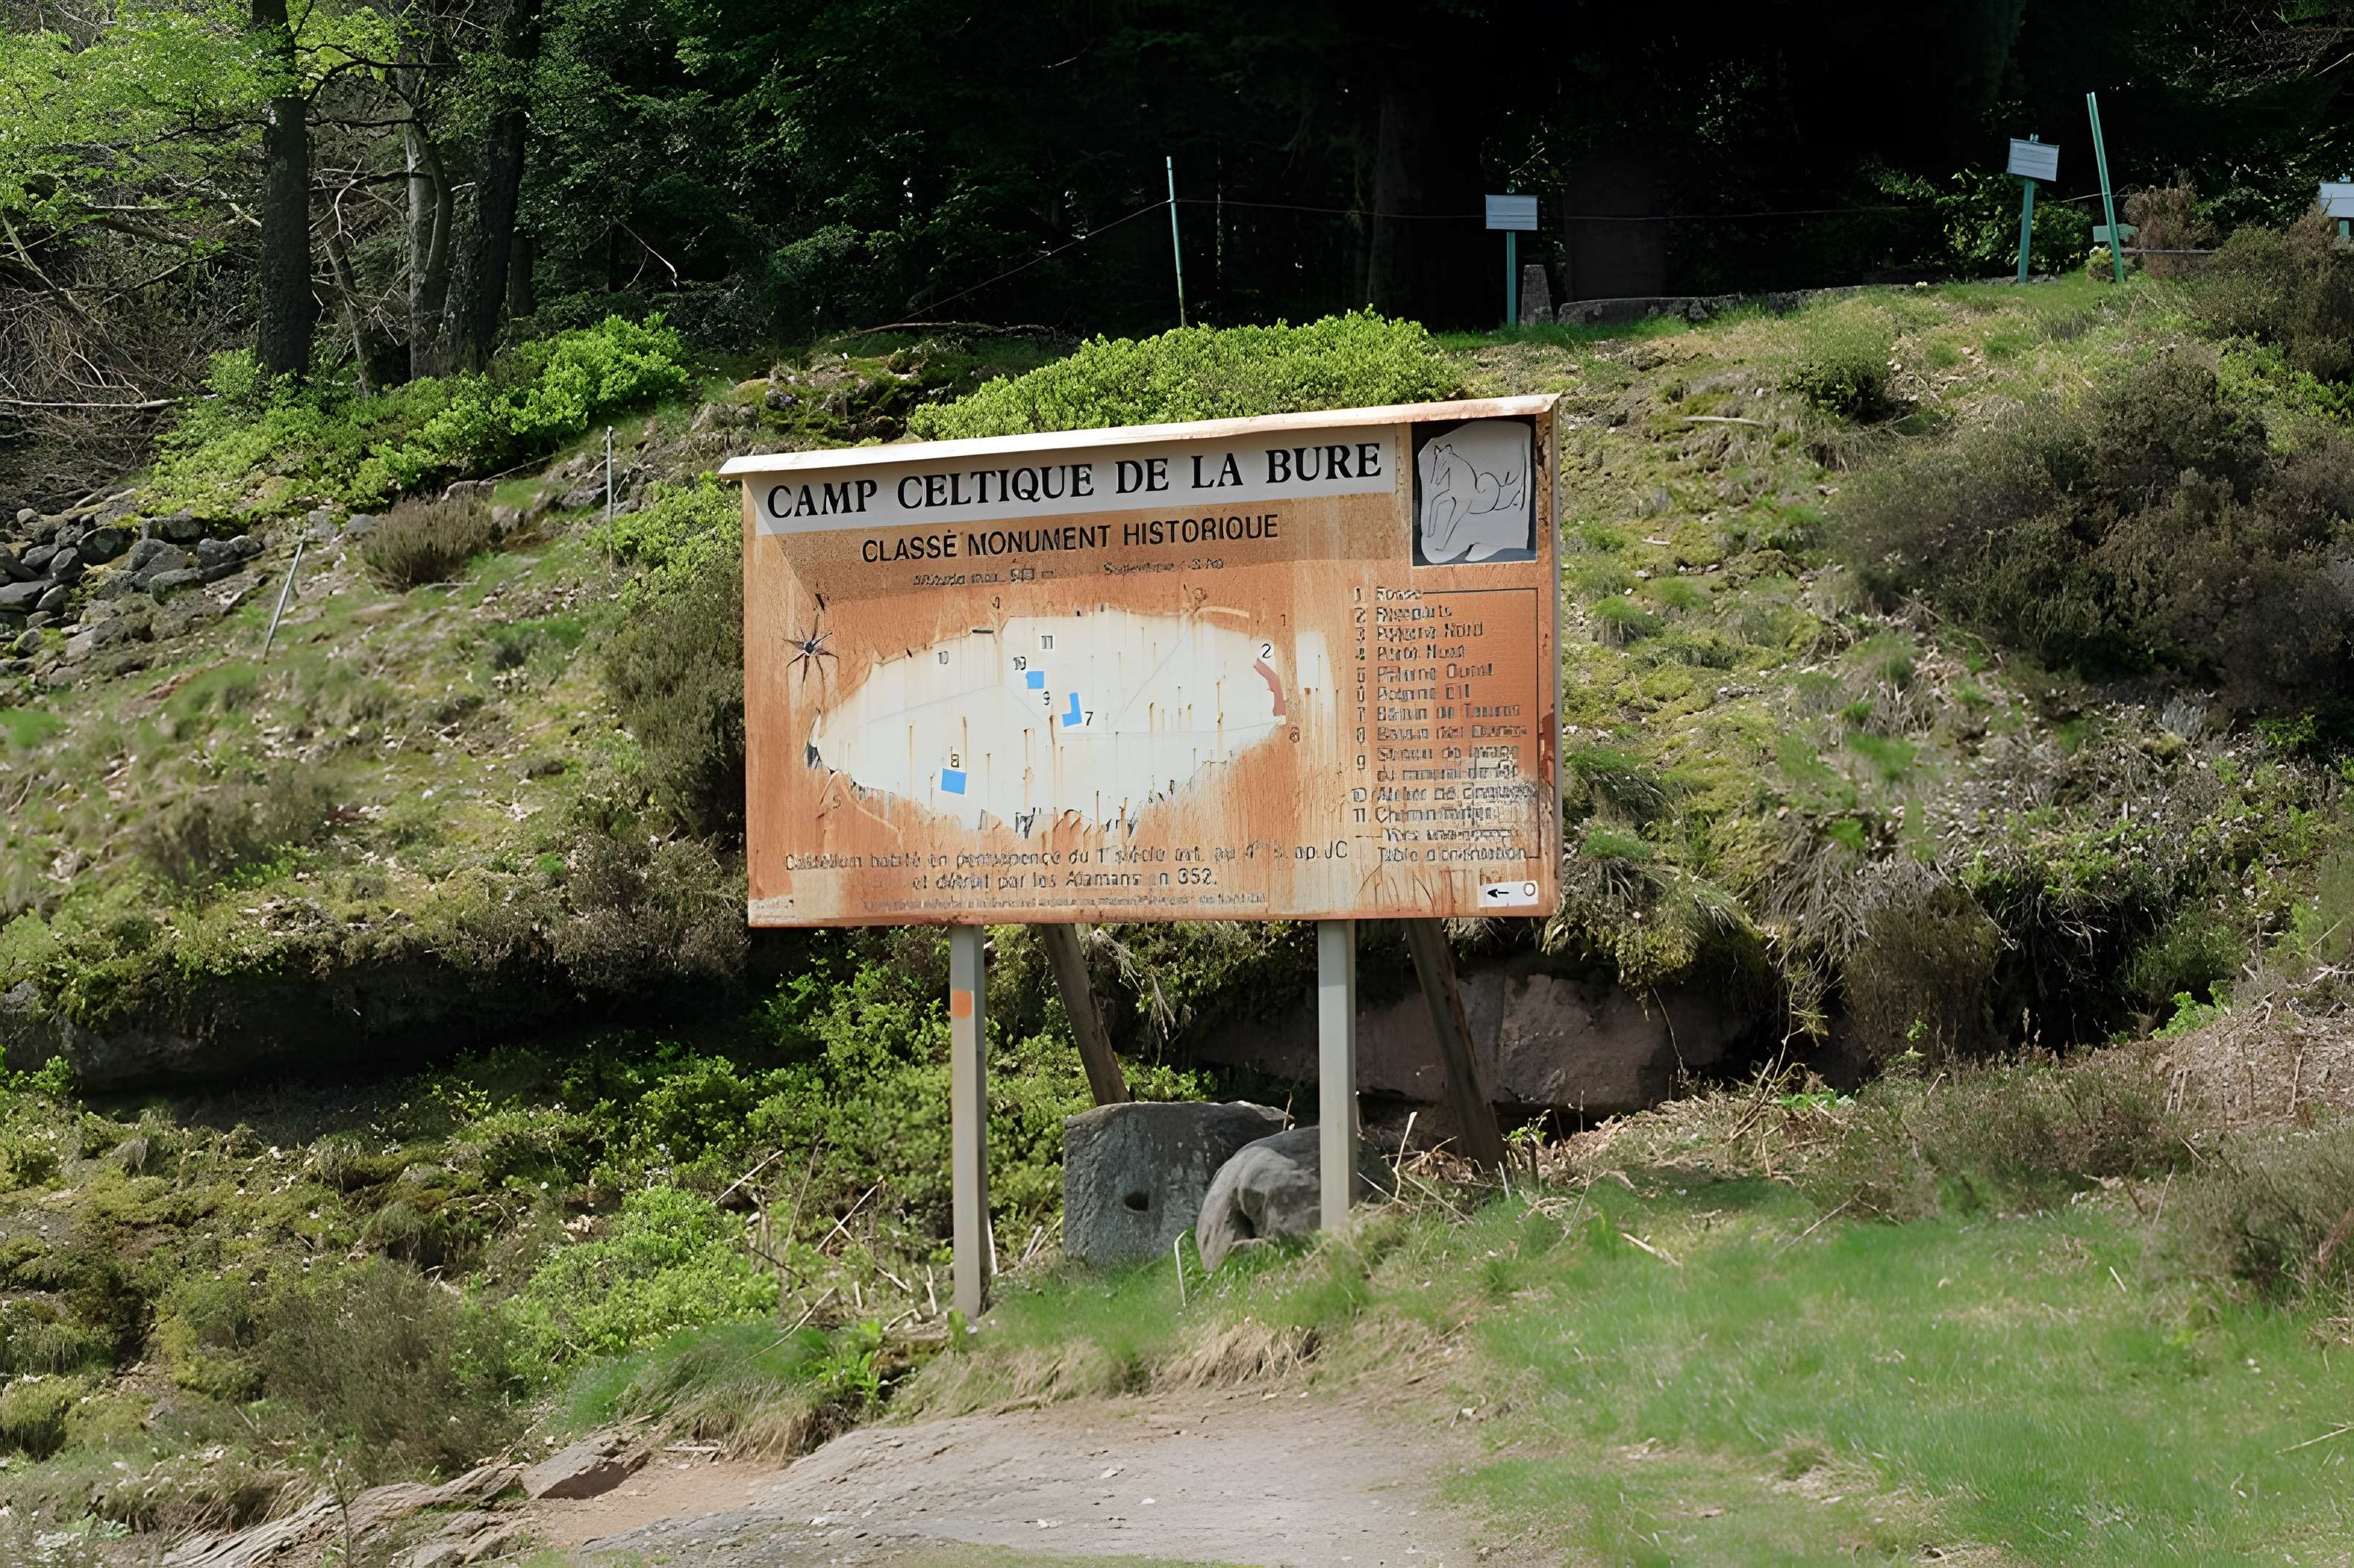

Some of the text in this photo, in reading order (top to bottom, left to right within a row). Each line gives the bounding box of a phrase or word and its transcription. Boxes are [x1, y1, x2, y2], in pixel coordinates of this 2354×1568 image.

[767, 443, 1382, 518] CAMP CELTIQUE DE LA BURE
[968, 524, 1111, 557] MONUMENT
[1261, 644, 1272, 659] 2
[1084, 711, 1094, 726] 7
